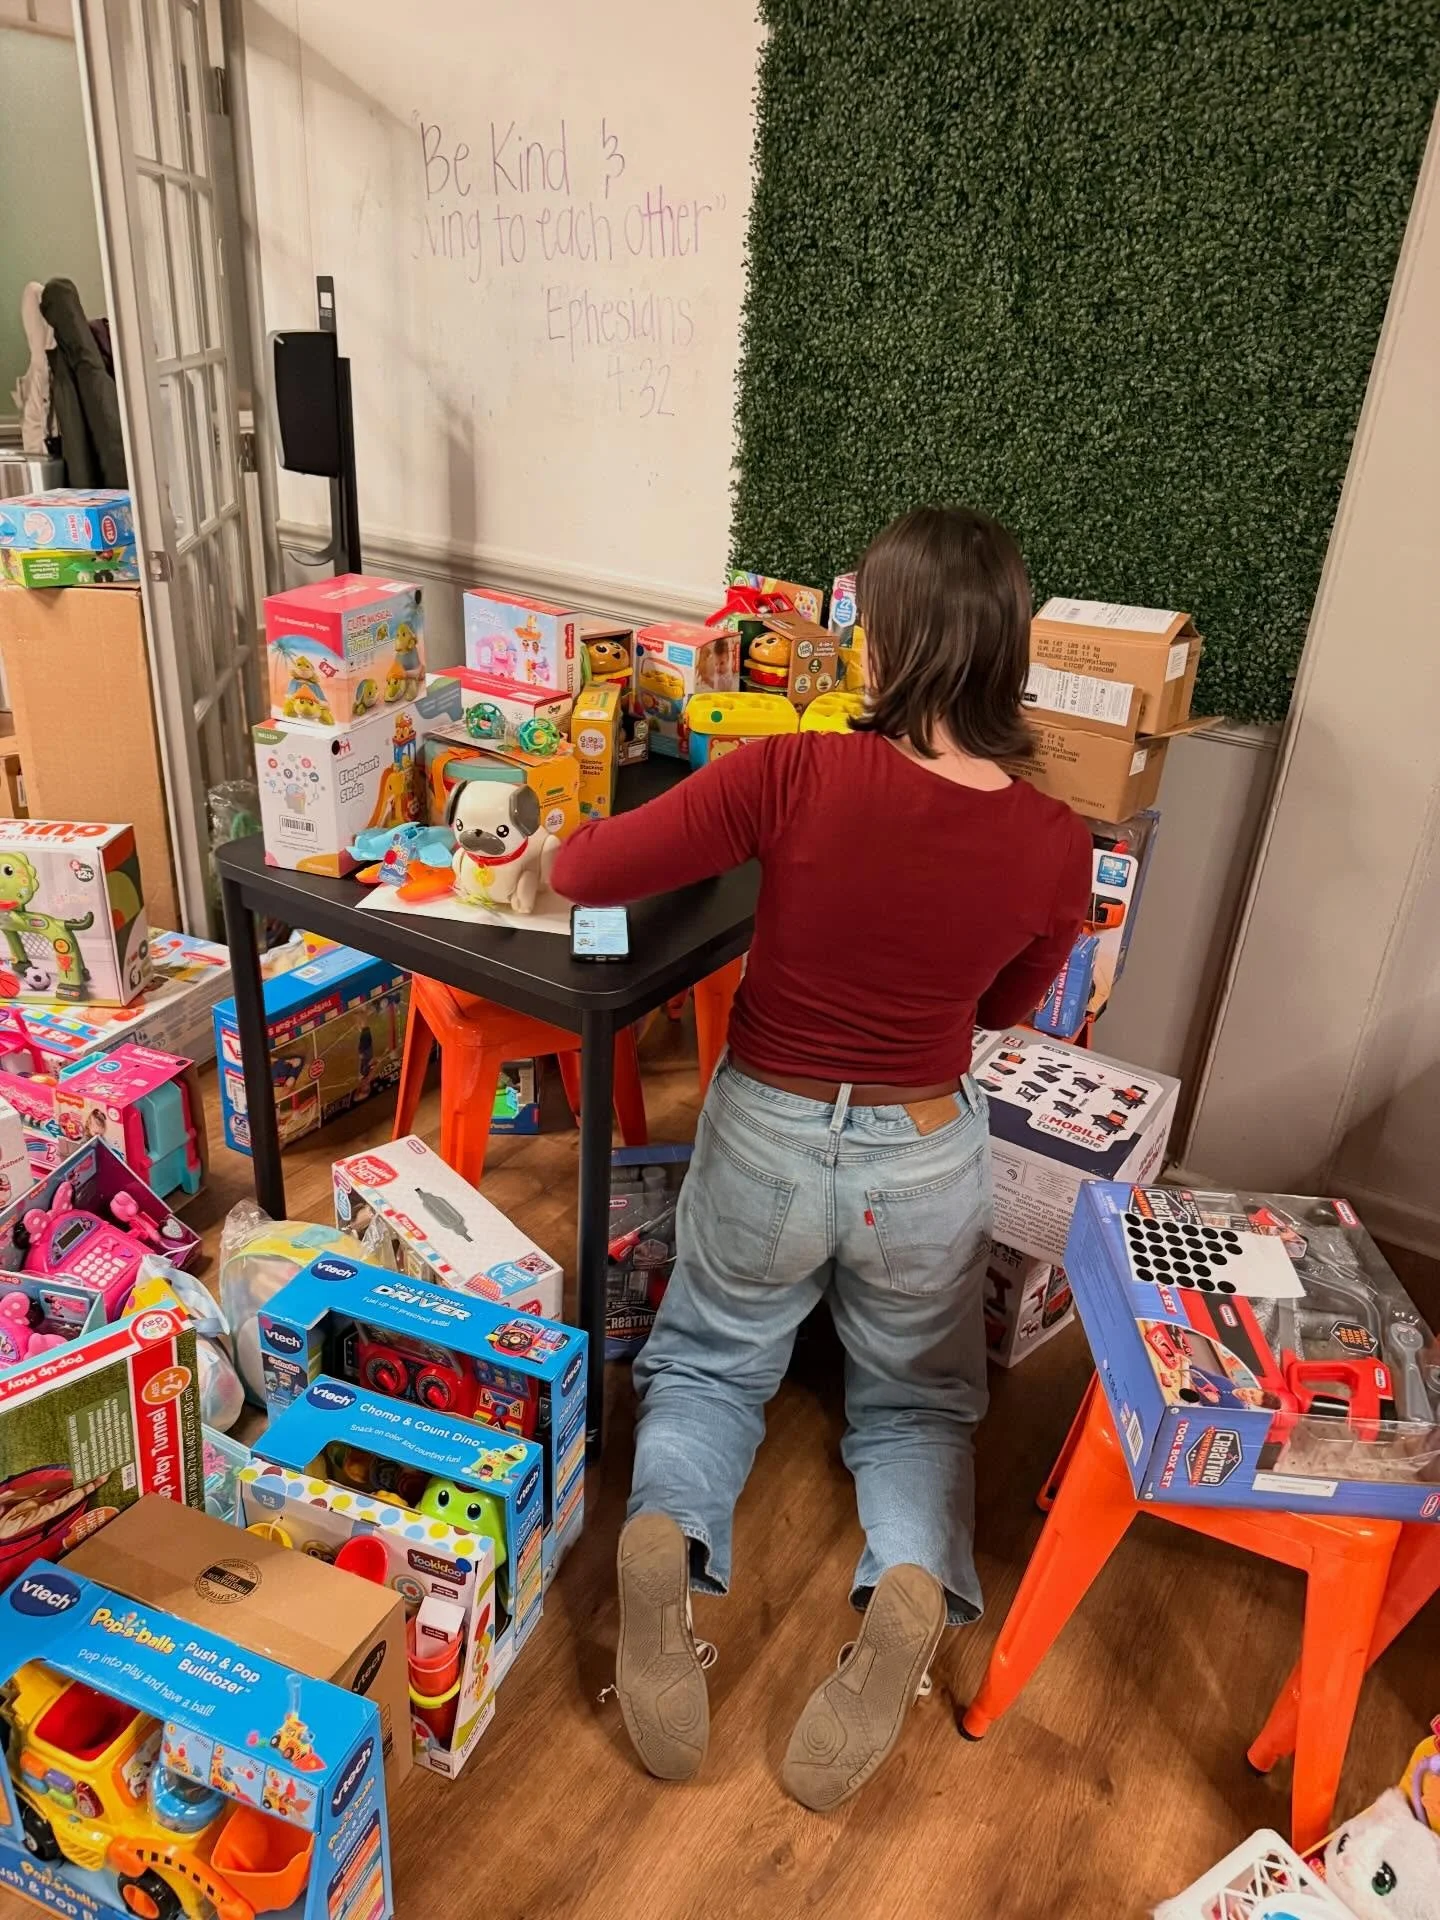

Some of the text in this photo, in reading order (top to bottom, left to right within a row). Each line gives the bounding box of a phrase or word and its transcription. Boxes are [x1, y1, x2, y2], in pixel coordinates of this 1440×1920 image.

[491, 119, 570, 196] Kind
[493, 204, 526, 266] to
[536, 202, 612, 262] each
[546, 286, 695, 362] Ephesians
[338, 755, 380, 787] Elephant
[340, 782, 364, 804] Slide
[1051, 996, 1061, 1027] HAMMER
[1036, 1119, 1102, 1149] Tool Table
[1048, 1116, 1108, 1143] MOBILE
[371, 1284, 472, 1321] DRIVER
[1163, 1294, 1178, 1313] SET
[7, 1354, 85, 1391] Pop-Up Play
[161, 1372, 182, 1395] 2+
[313, 1386, 350, 1406] vtech
[146, 1406, 169, 1457] Tunnel
[350, 1424, 373, 1434] Snack
[402, 1439, 416, 1450] and
[415, 1445, 445, 1463] counting
[445, 1454, 462, 1464] fun!
[359, 1403, 483, 1448] Chomp & Count Dino
[151, 1455, 175, 1487] Play
[1161, 1421, 1190, 1488] TOOL BOX SET
[1192, 1428, 1215, 1483] CONSTRUCTION
[206, 1571, 250, 1594] FRUSTRATION
[411, 1552, 462, 1577] Yookidoo
[22, 1580, 71, 1609] vtech
[177, 1658, 245, 1695] Bulldozer
[184, 1641, 219, 1664] Push
[218, 1657, 232, 1671] &
[231, 1662, 261, 1684] Pop
[77, 1648, 101, 1662] Pop
[100, 1652, 122, 1668] into
[121, 1662, 145, 1681] play
[144, 1673, 165, 1691] and
[160, 1683, 184, 1703] have
[190, 1699, 217, 1717] ball!
[0, 1867, 24, 1887] ush
[28, 1880, 40, 1895] &
[44, 1888, 78, 1916] Pop
